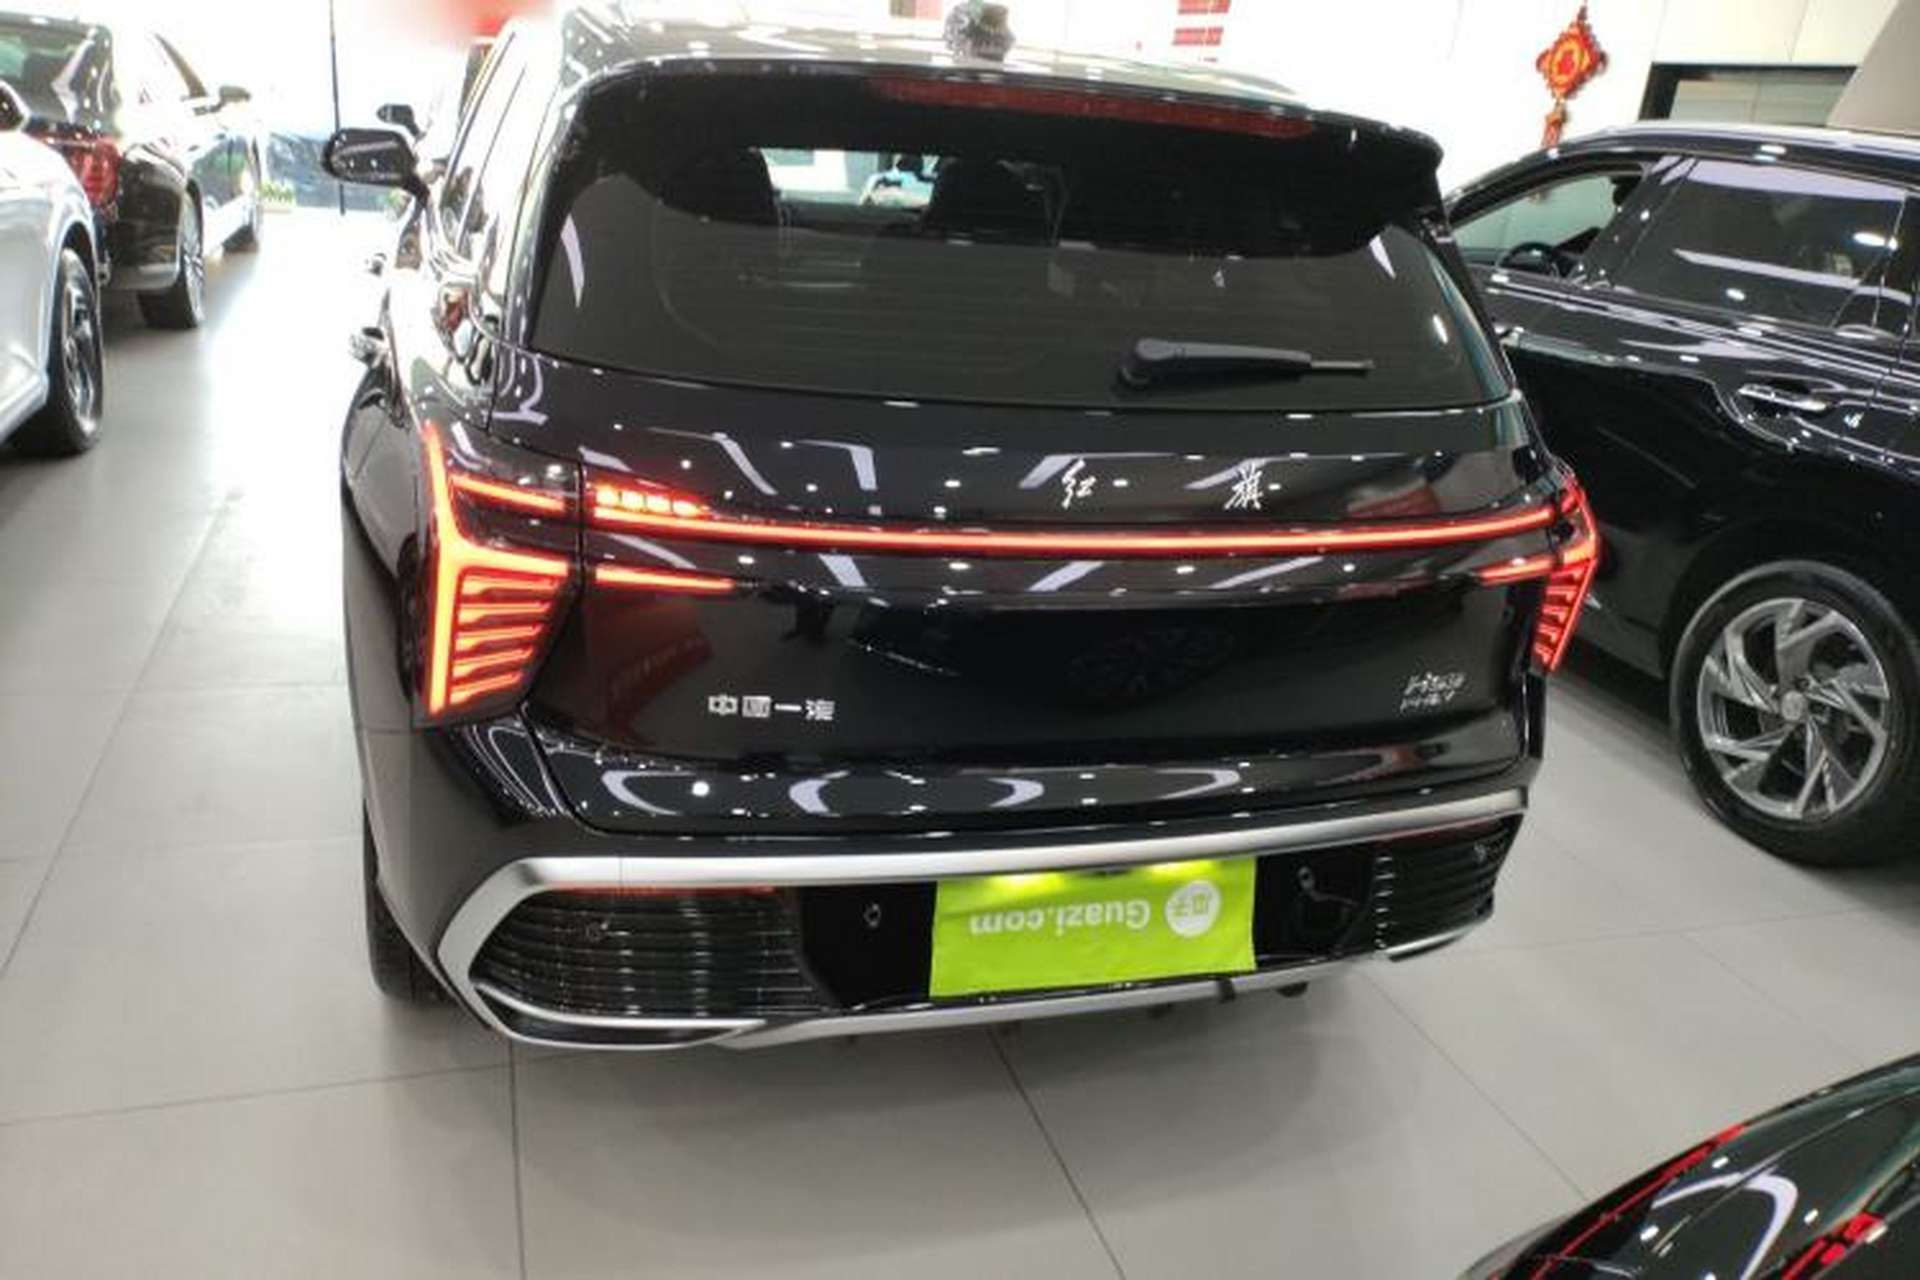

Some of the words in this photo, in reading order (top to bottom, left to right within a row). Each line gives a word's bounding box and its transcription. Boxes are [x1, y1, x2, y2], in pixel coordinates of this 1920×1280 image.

[708, 695, 836, 721] 中国一汽
[969, 900, 1151, 936] Guazi.com
